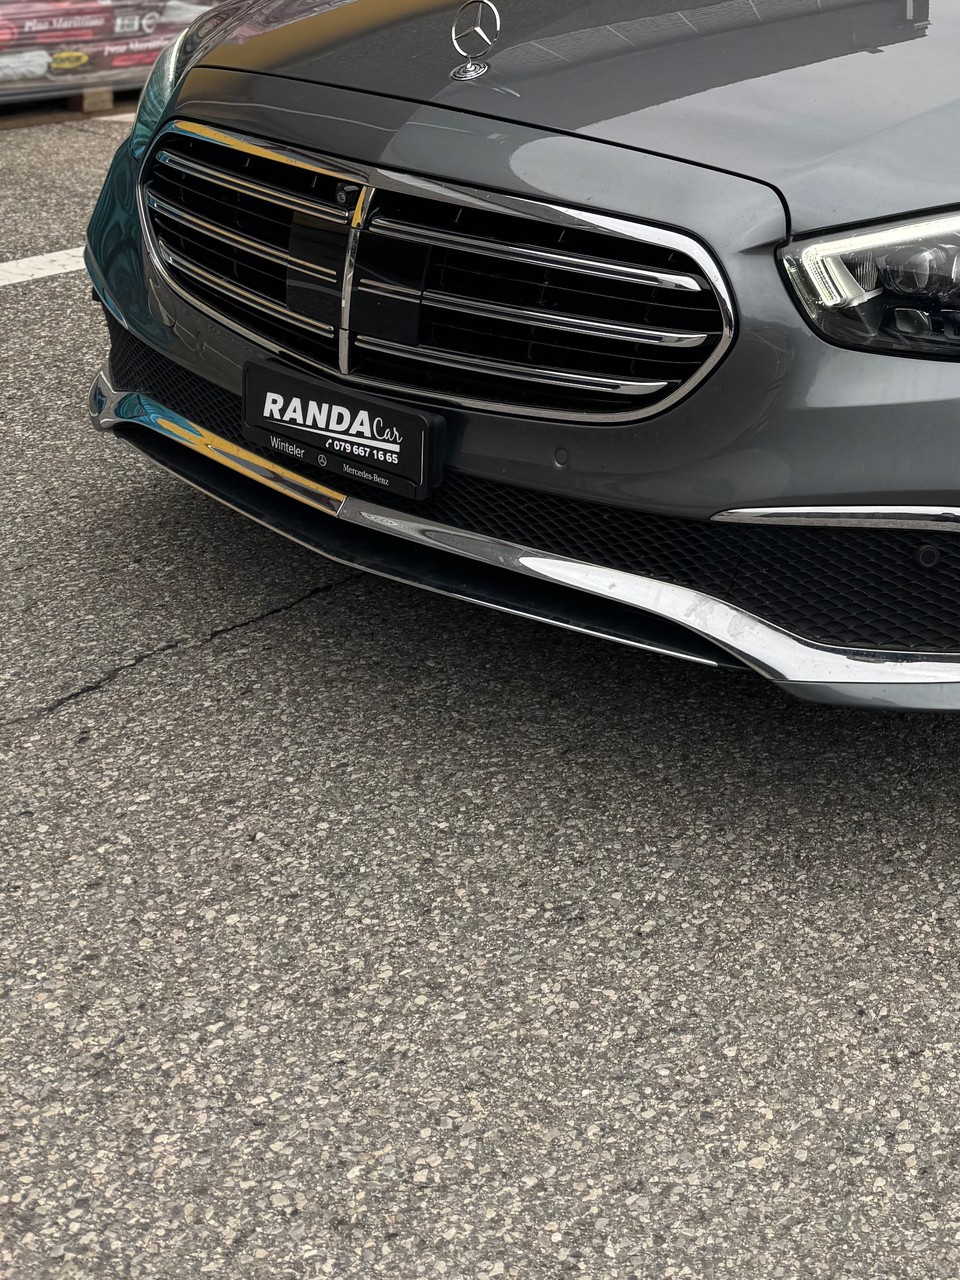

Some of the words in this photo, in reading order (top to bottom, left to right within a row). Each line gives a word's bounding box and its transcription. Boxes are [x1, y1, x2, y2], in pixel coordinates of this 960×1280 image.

[263, 392, 372, 438] RANDA
[373, 417, 403, 443] Car
[270, 435, 305, 459] Winteler
[334, 440, 351, 453] 079
[352, 444, 370, 457] 667
[373, 449, 385, 461] 16
[386, 452, 399, 465] 65
[342, 463, 389, 486] Mercedes-Benz
